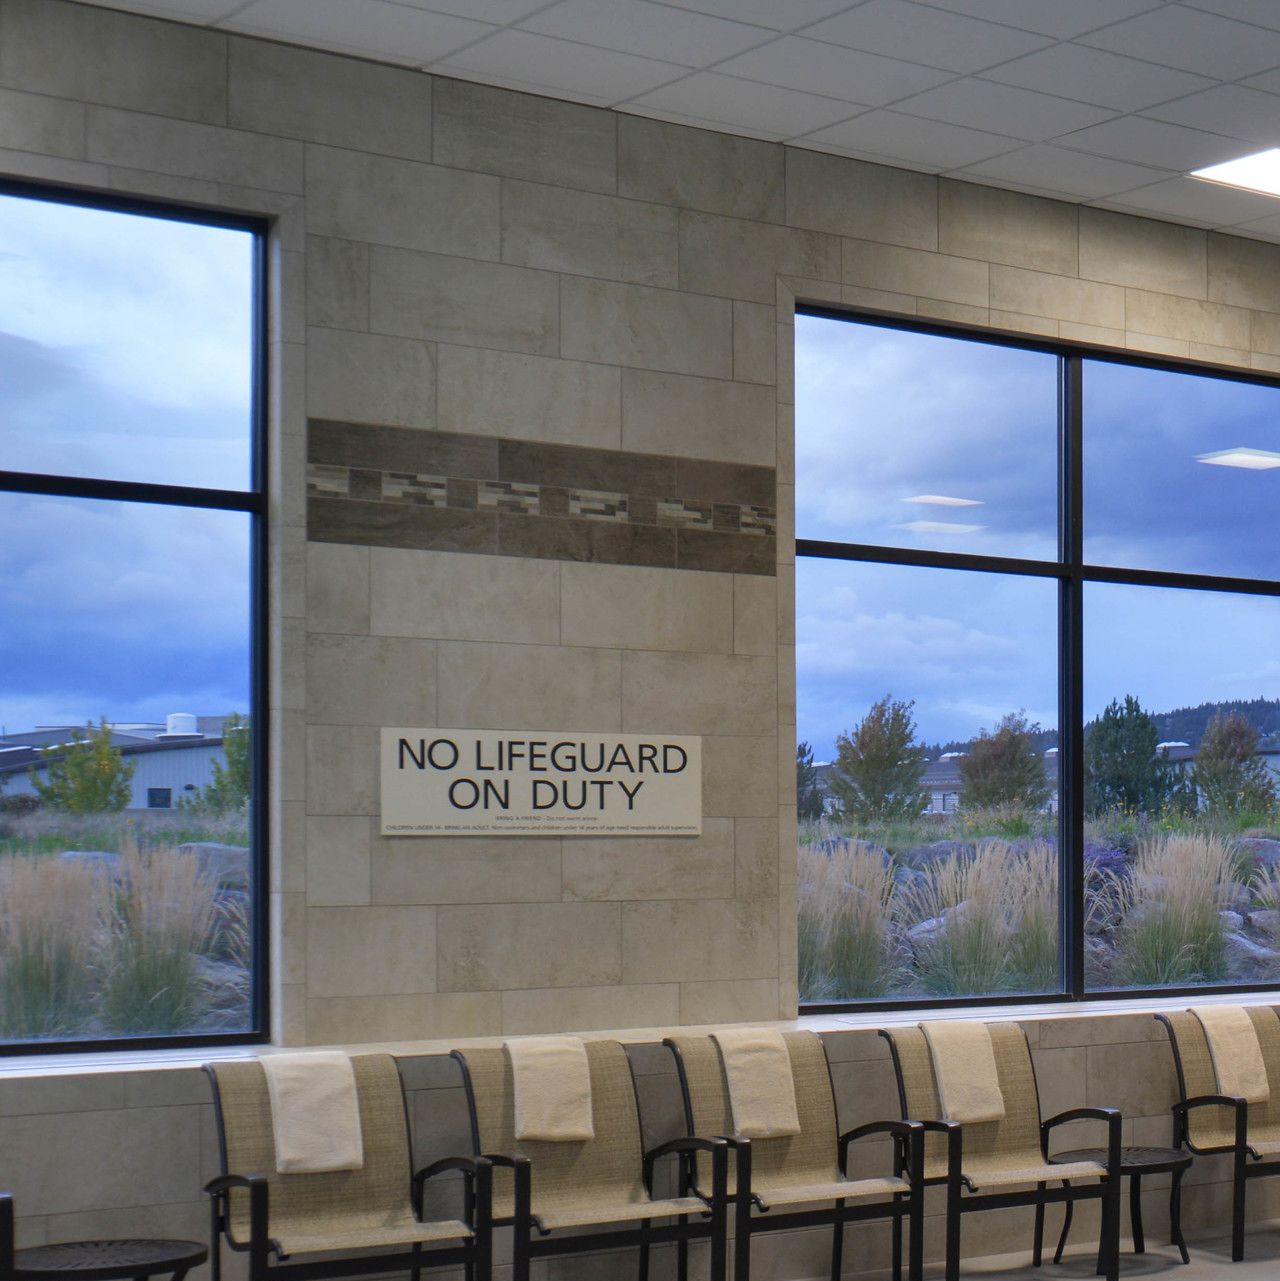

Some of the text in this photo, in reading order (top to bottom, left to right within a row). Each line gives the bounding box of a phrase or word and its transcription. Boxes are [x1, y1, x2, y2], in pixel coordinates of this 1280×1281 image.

[398, 738, 688, 774] NO LIFEGUARD
[448, 778, 645, 811] ON DUTY
